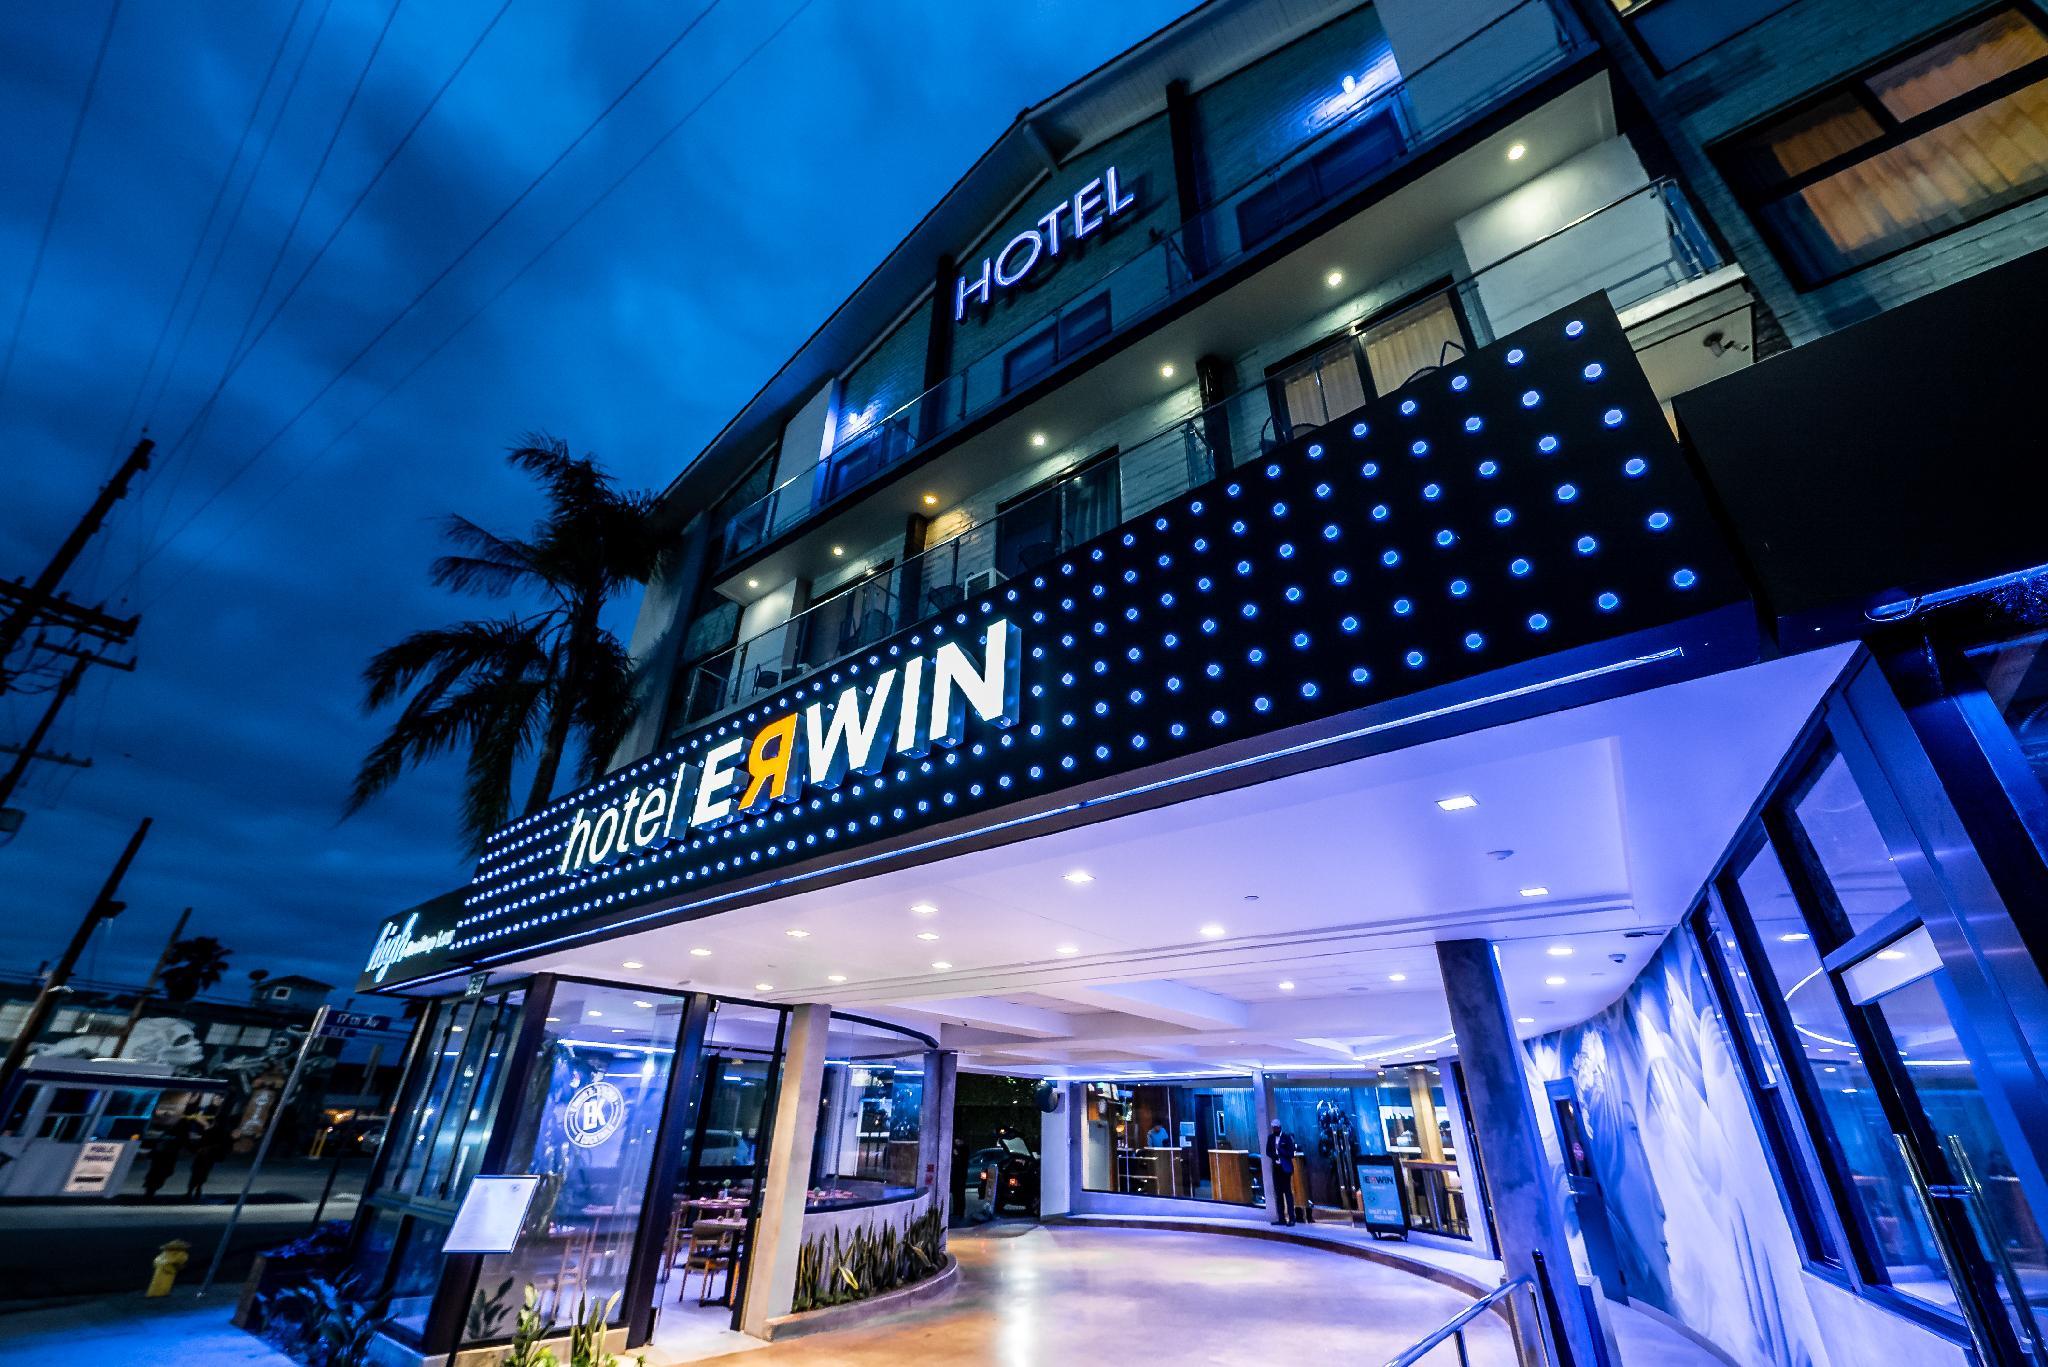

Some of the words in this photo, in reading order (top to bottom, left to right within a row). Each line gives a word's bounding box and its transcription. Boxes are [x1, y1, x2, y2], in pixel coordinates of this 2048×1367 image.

[955, 166, 1134, 321] HOTEL
[560, 763, 688, 876] hotel
[689, 618, 1010, 829] ERWIN
[364, 912, 419, 983] high
